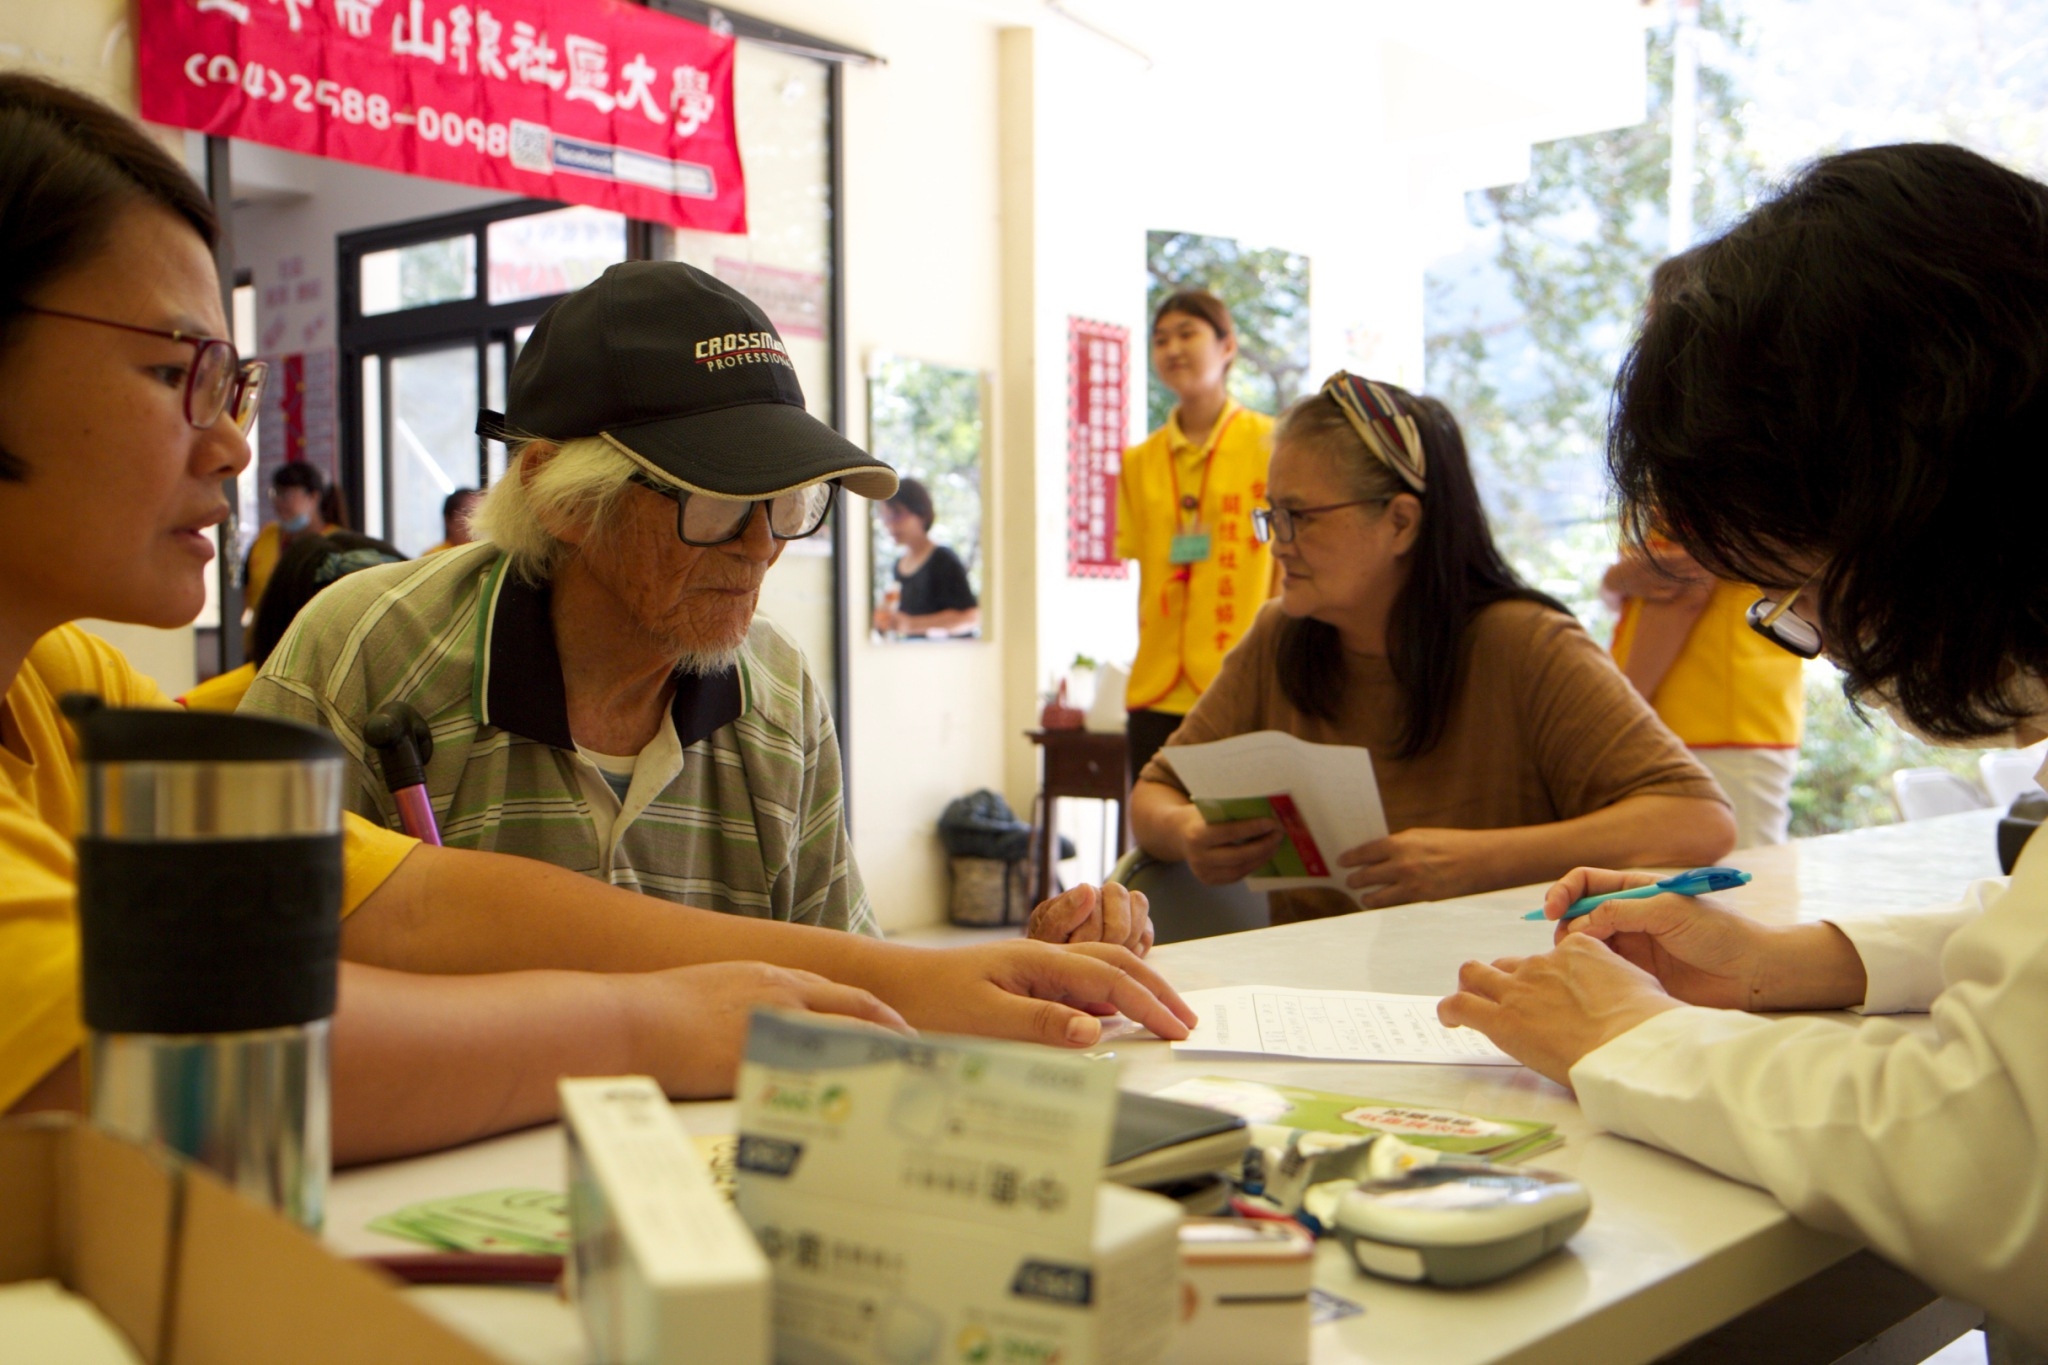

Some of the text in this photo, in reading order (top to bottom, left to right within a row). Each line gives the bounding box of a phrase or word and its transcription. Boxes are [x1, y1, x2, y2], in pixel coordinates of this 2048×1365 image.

[197, 0, 714, 137] 市山線社區大學
